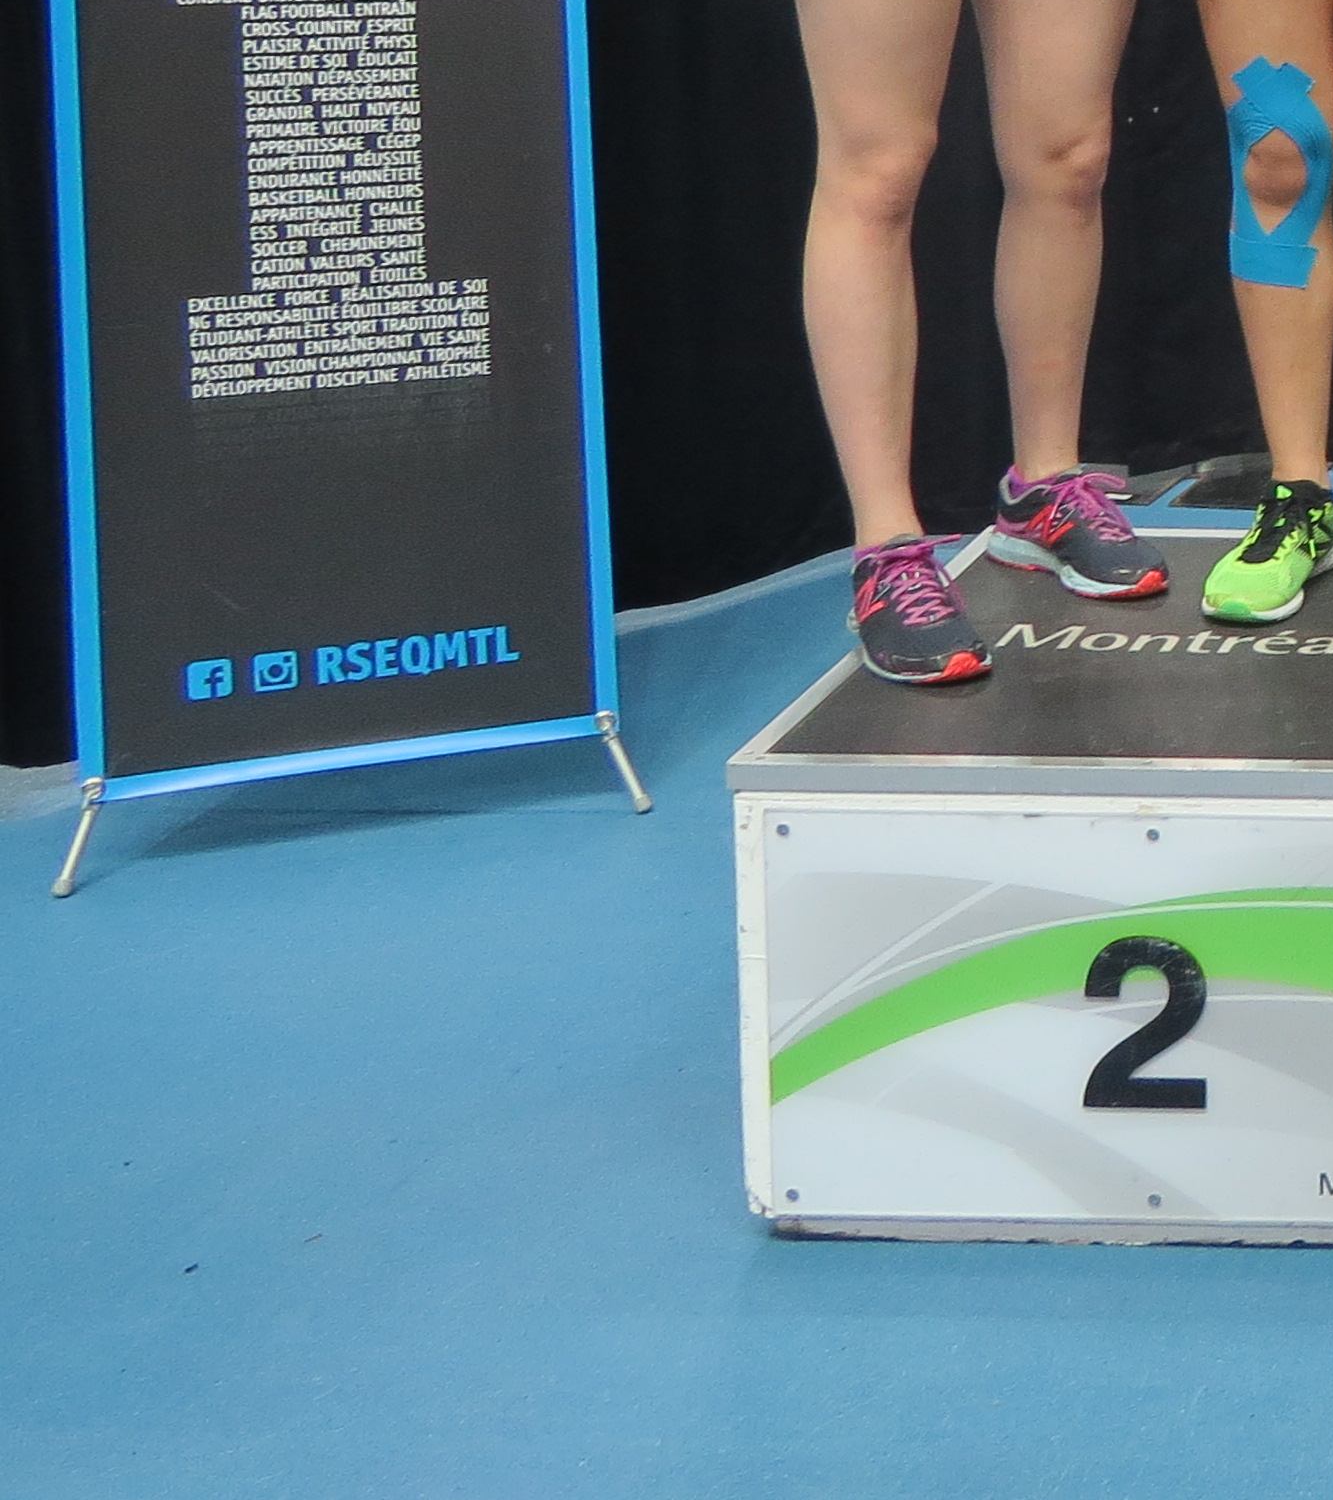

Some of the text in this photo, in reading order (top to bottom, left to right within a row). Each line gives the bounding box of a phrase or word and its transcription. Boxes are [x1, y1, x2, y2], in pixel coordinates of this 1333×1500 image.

[242, 17, 415, 37] CROSS-COUNTRY ESPRIT
[243, 64, 417, 88] NATATION DÉPASSEMENT
[246, 100, 420, 122] GRANDIR HAUT NIVEAU
[247, 130, 421, 156] APPRENTISSAGE CÉGEP
[247, 147, 421, 173] COMPÉTITION RÉUSSITE
[252, 263, 426, 292] PARTICIPATION ÉTOILES
[191, 342, 490, 382] PASSION VISION CHAMPIONNAT TROPHÉE
[316, 625, 520, 685] RSEQMTL
[1083, 935, 1208, 1109] 2
